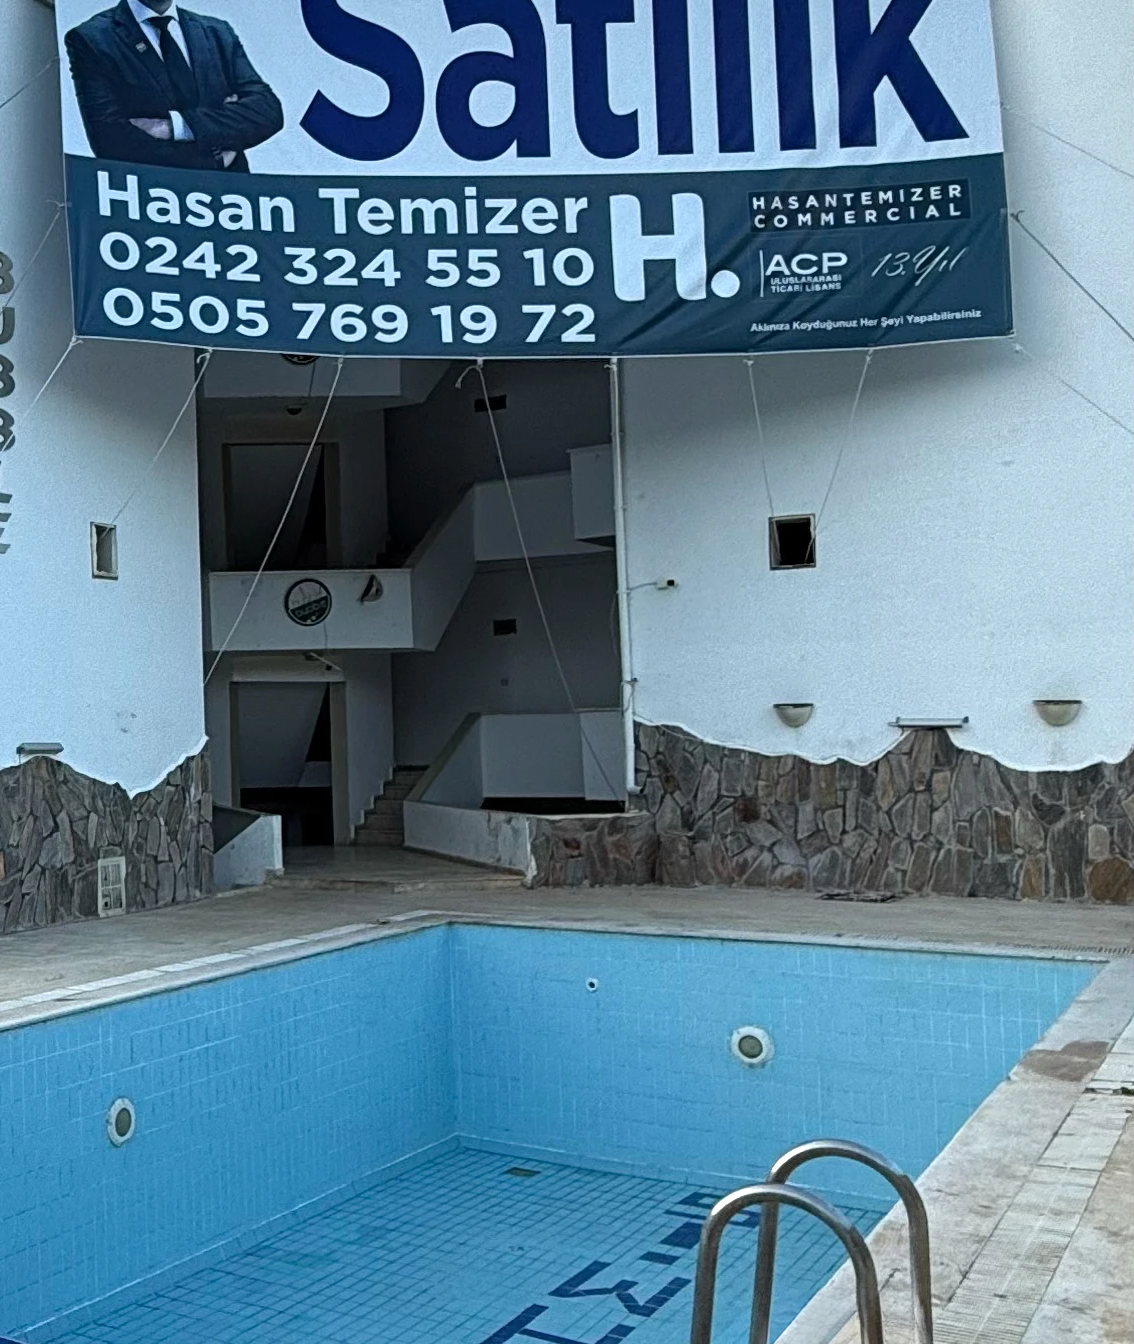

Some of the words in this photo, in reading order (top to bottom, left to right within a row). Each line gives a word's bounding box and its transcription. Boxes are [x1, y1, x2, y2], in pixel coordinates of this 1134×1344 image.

[96, 169, 296, 235] Hasan
[318, 185, 589, 236] Temizer
[753, 203, 962, 229] COMMERCIAL
[98, 231, 262, 283] 0242
[283, 245, 402, 288] 324
[424, 247, 502, 289] 55
[522, 246, 596, 288] 10
[609, 192, 741, 302] H.
[765, 251, 848, 276] ACP
[102, 286, 269, 338] 0505
[291, 302, 410, 344] 769
[430, 303, 498, 345] 19
[521, 303, 597, 344] 72
[860, 318, 878, 327] Her
